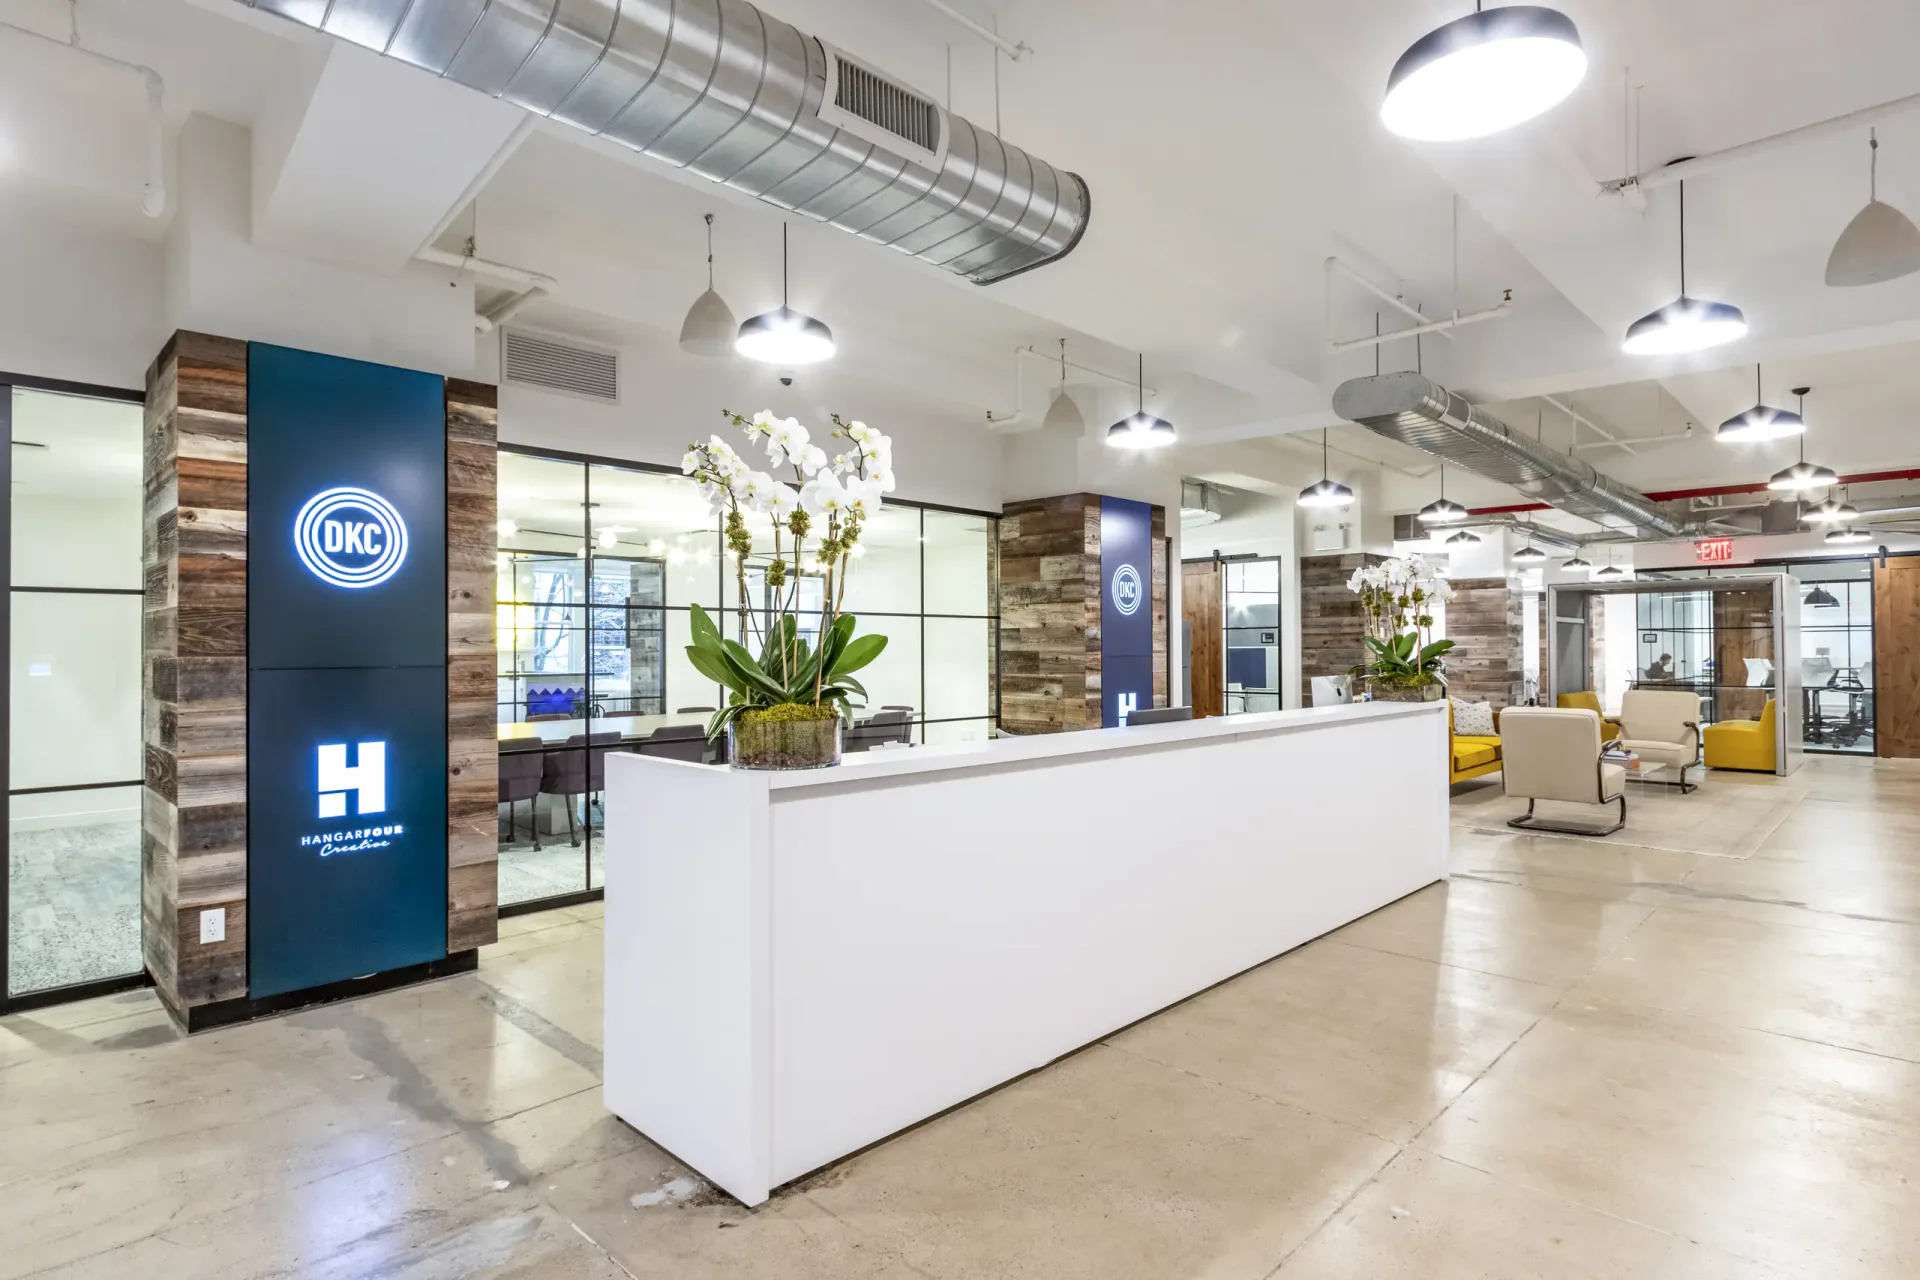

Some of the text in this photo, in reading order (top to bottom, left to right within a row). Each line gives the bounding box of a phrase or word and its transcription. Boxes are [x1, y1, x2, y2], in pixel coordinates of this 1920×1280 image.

[324, 519, 382, 555] DKC
[1701, 541, 1729, 561] EXIT
[1119, 581, 1135, 599] DKC
[1118, 692, 1137, 727] H
[318, 741, 386, 819] H
[301, 825, 403, 846] HANGARFOUR
[320, 839, 390, 857] Creative
